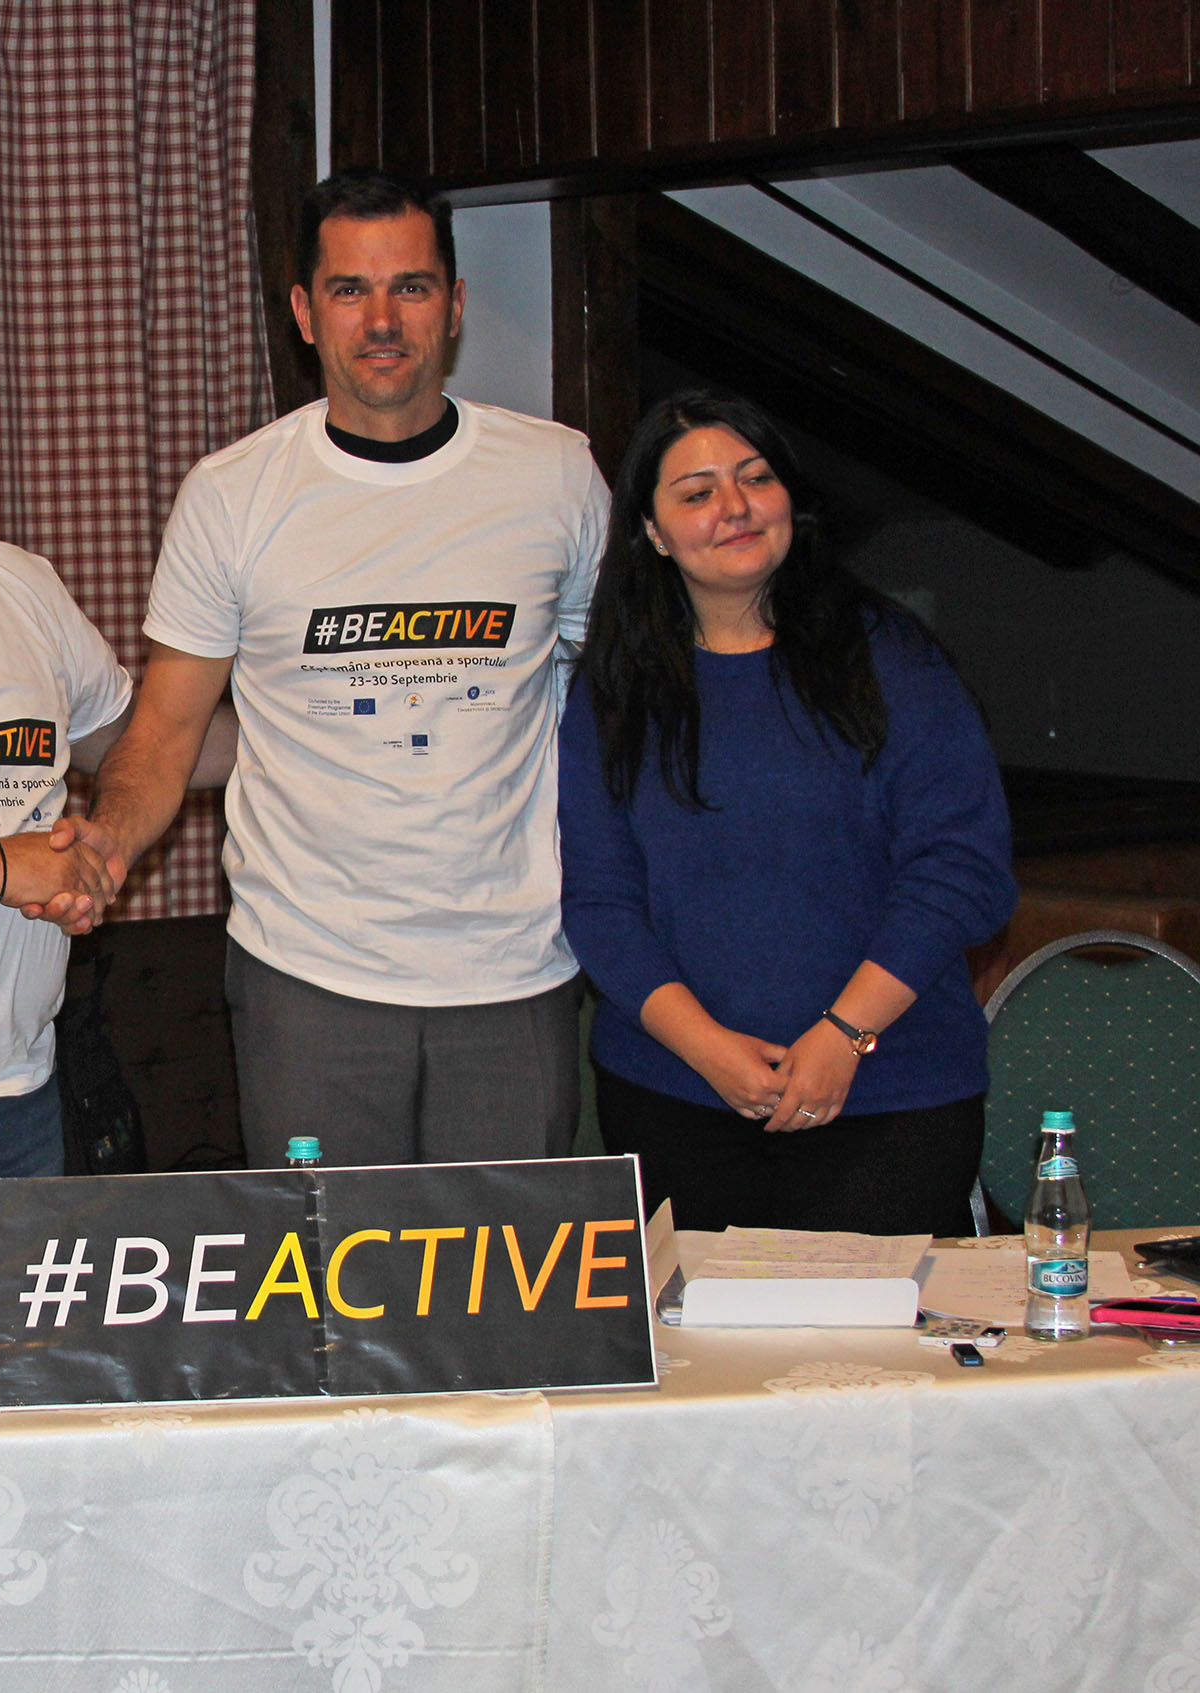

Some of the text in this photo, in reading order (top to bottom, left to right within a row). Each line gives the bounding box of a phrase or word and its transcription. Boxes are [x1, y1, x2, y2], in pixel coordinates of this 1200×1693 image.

[314, 609, 508, 646] #BEACTIVE
[446, 657, 453, 665] a
[391, 673, 458, 687] Septembrie
[12, 780, 19, 789] a
[21, 776, 58, 792] sportul
[19, 1219, 636, 1327] #BEACTIVE
